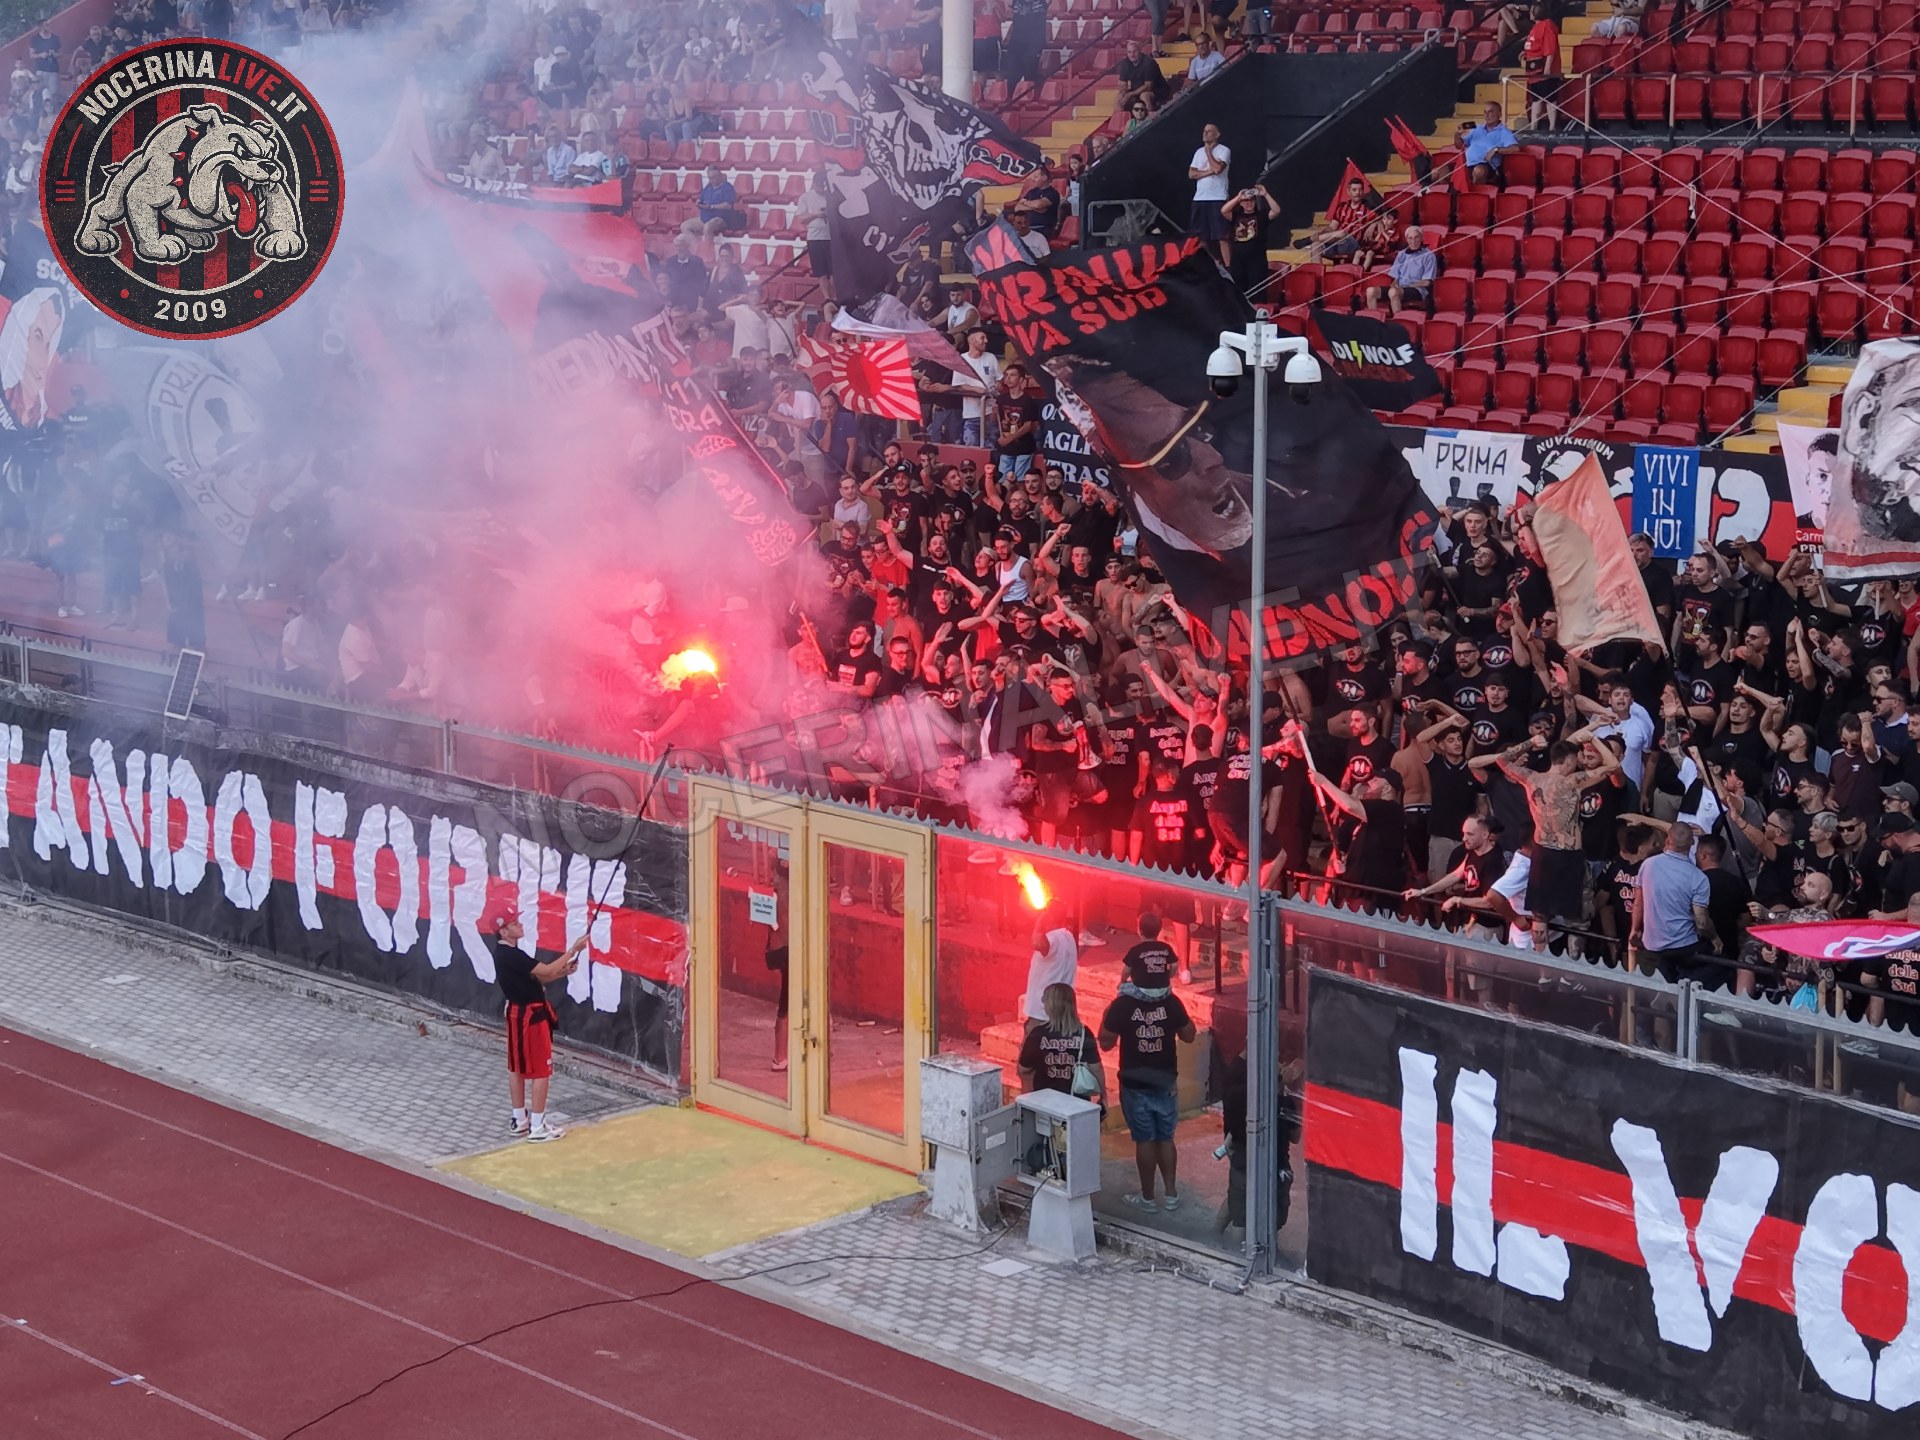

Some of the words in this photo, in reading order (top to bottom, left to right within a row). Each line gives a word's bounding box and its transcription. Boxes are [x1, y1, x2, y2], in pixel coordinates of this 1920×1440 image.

[1436, 442, 1508, 476] PRIMA
[1643, 454, 1690, 487] VIVI
[1651, 489, 1675, 516] IN
[1643, 518, 1682, 550] NOI
[295, 778, 627, 1013] FORTE
[1888, 963, 1919, 979] della
[1891, 979, 1917, 995] Sud
[1131, 1007, 1167, 1024] Ageli
[1040, 1036, 1081, 1051] Angeli
[1138, 1039, 1163, 1052] Sud
[1045, 1052, 1075, 1066] della
[1048, 1066, 1071, 1079] Sud
[1398, 1046, 1571, 1302] IL
